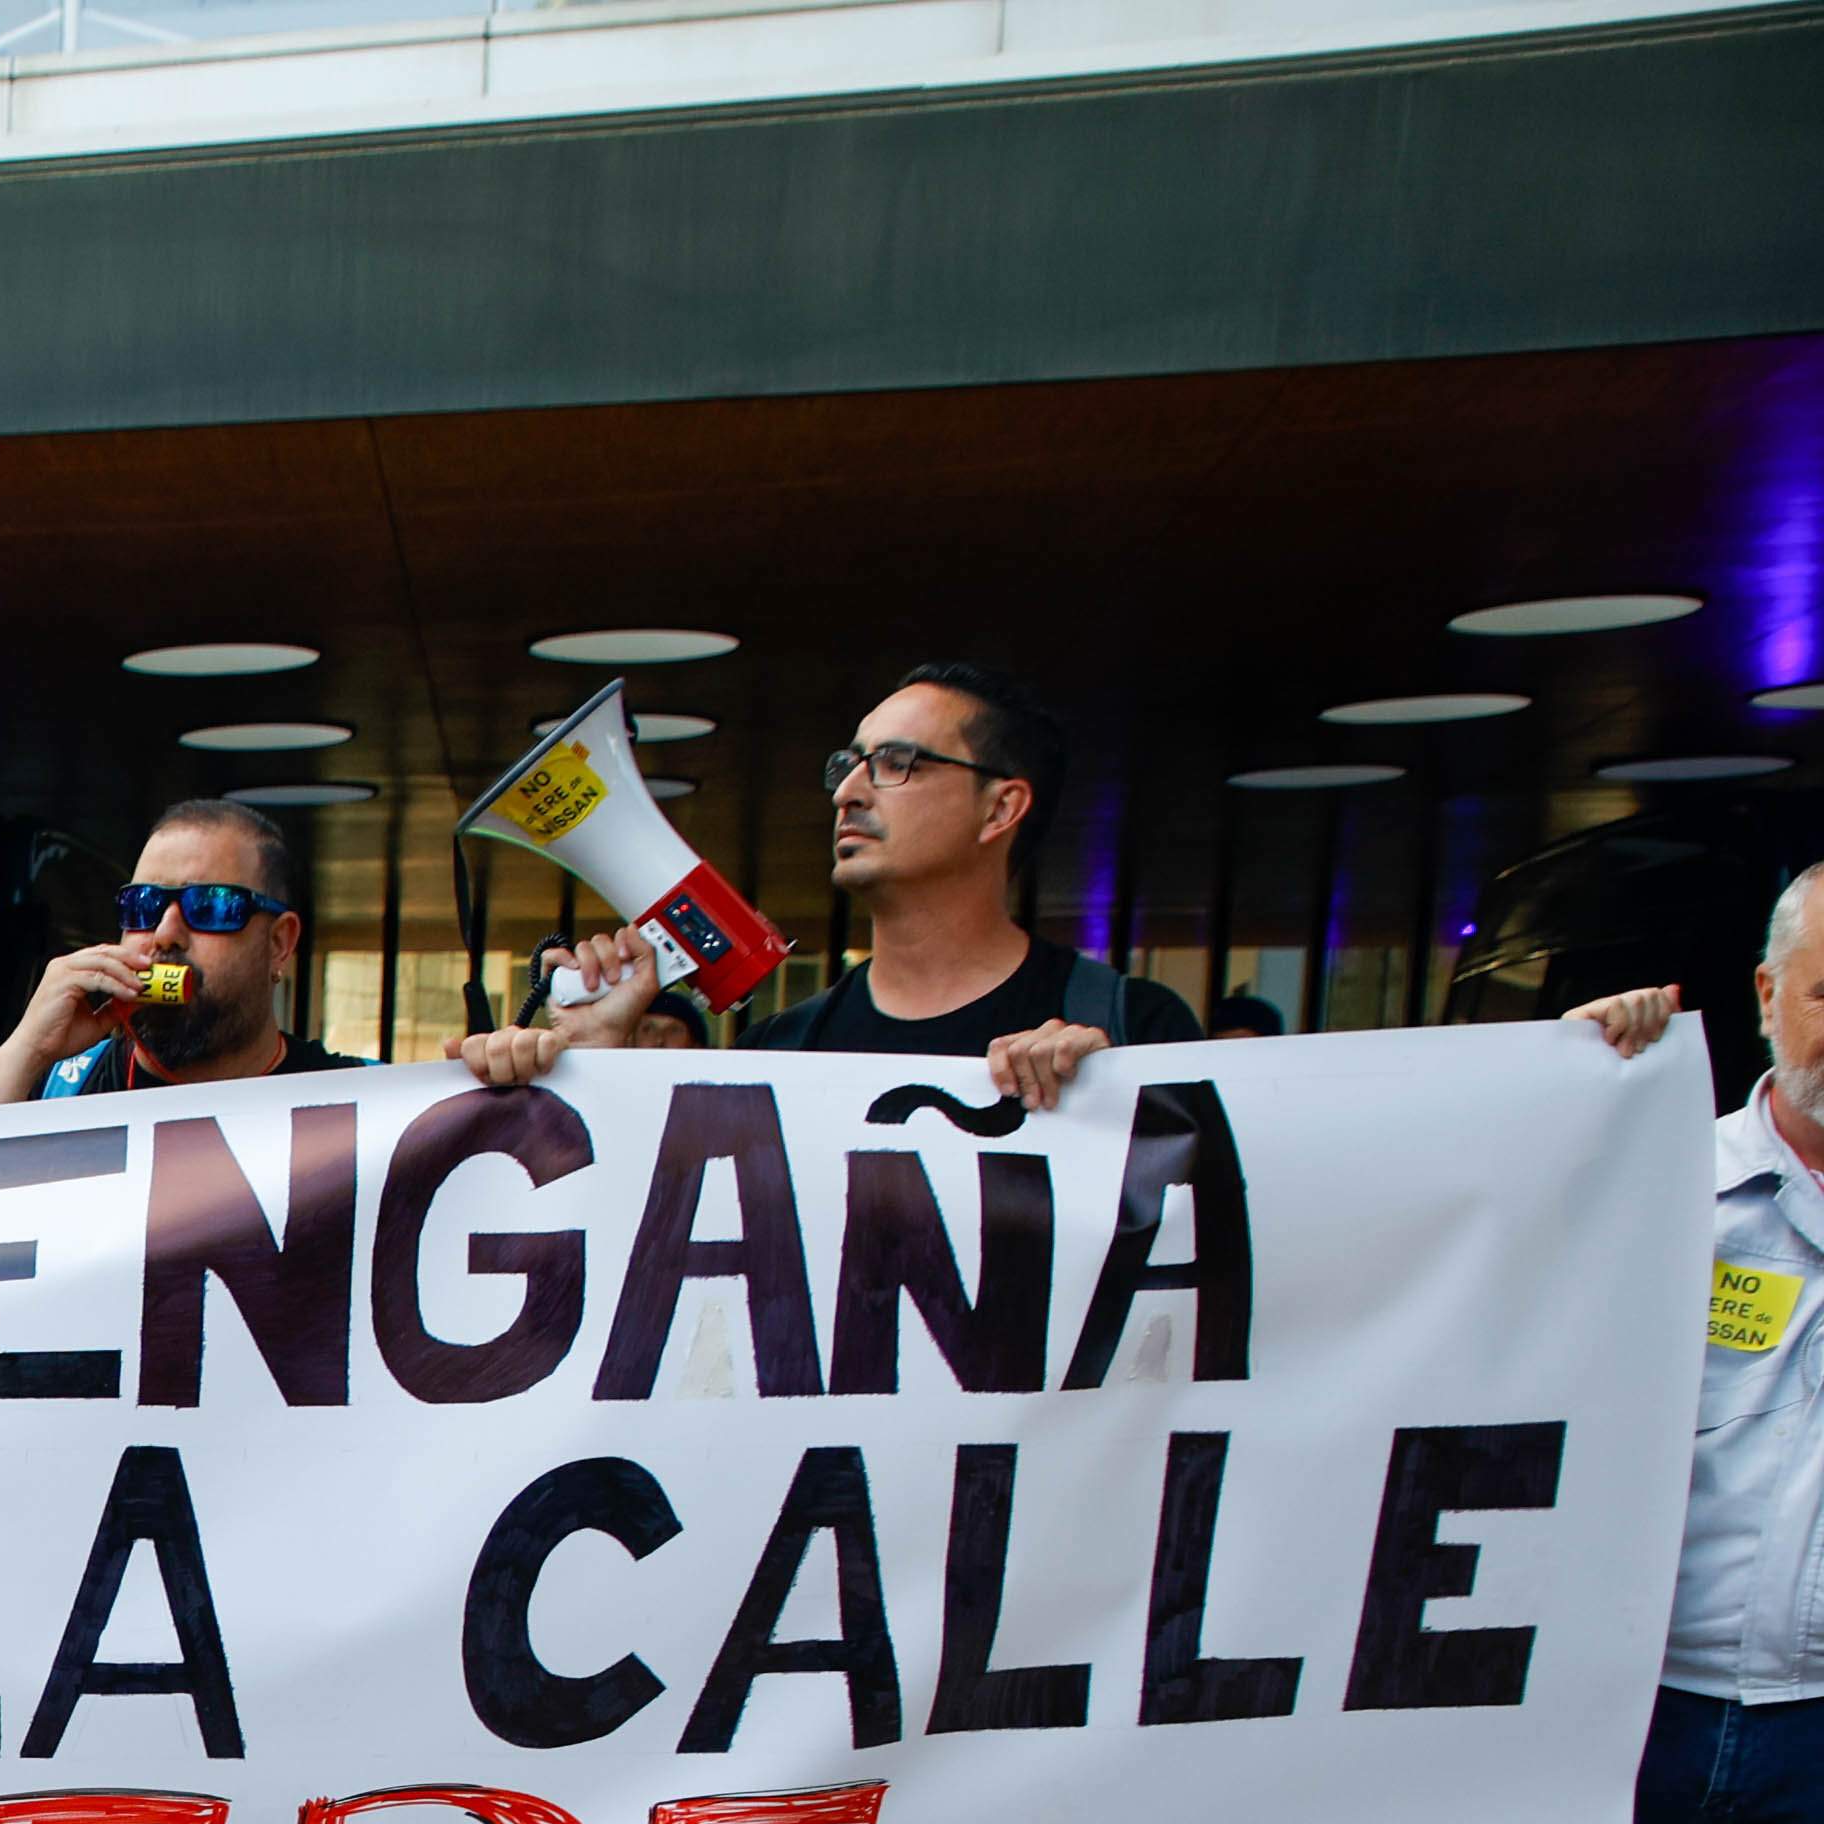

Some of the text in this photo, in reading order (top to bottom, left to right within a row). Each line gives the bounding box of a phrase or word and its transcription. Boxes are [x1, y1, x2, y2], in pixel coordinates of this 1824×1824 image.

[519, 770, 551, 798] NO
[533, 785, 570, 816] ERE
[536, 785, 599, 834] NISSAN
[162, 970, 181, 1002] ERE
[1719, 1271, 1762, 1294] NO
[1708, 1296, 1754, 1319] ERE
[1706, 1320, 1768, 1346] SSAN
[460, 1420, 1568, 1755] CALLE
